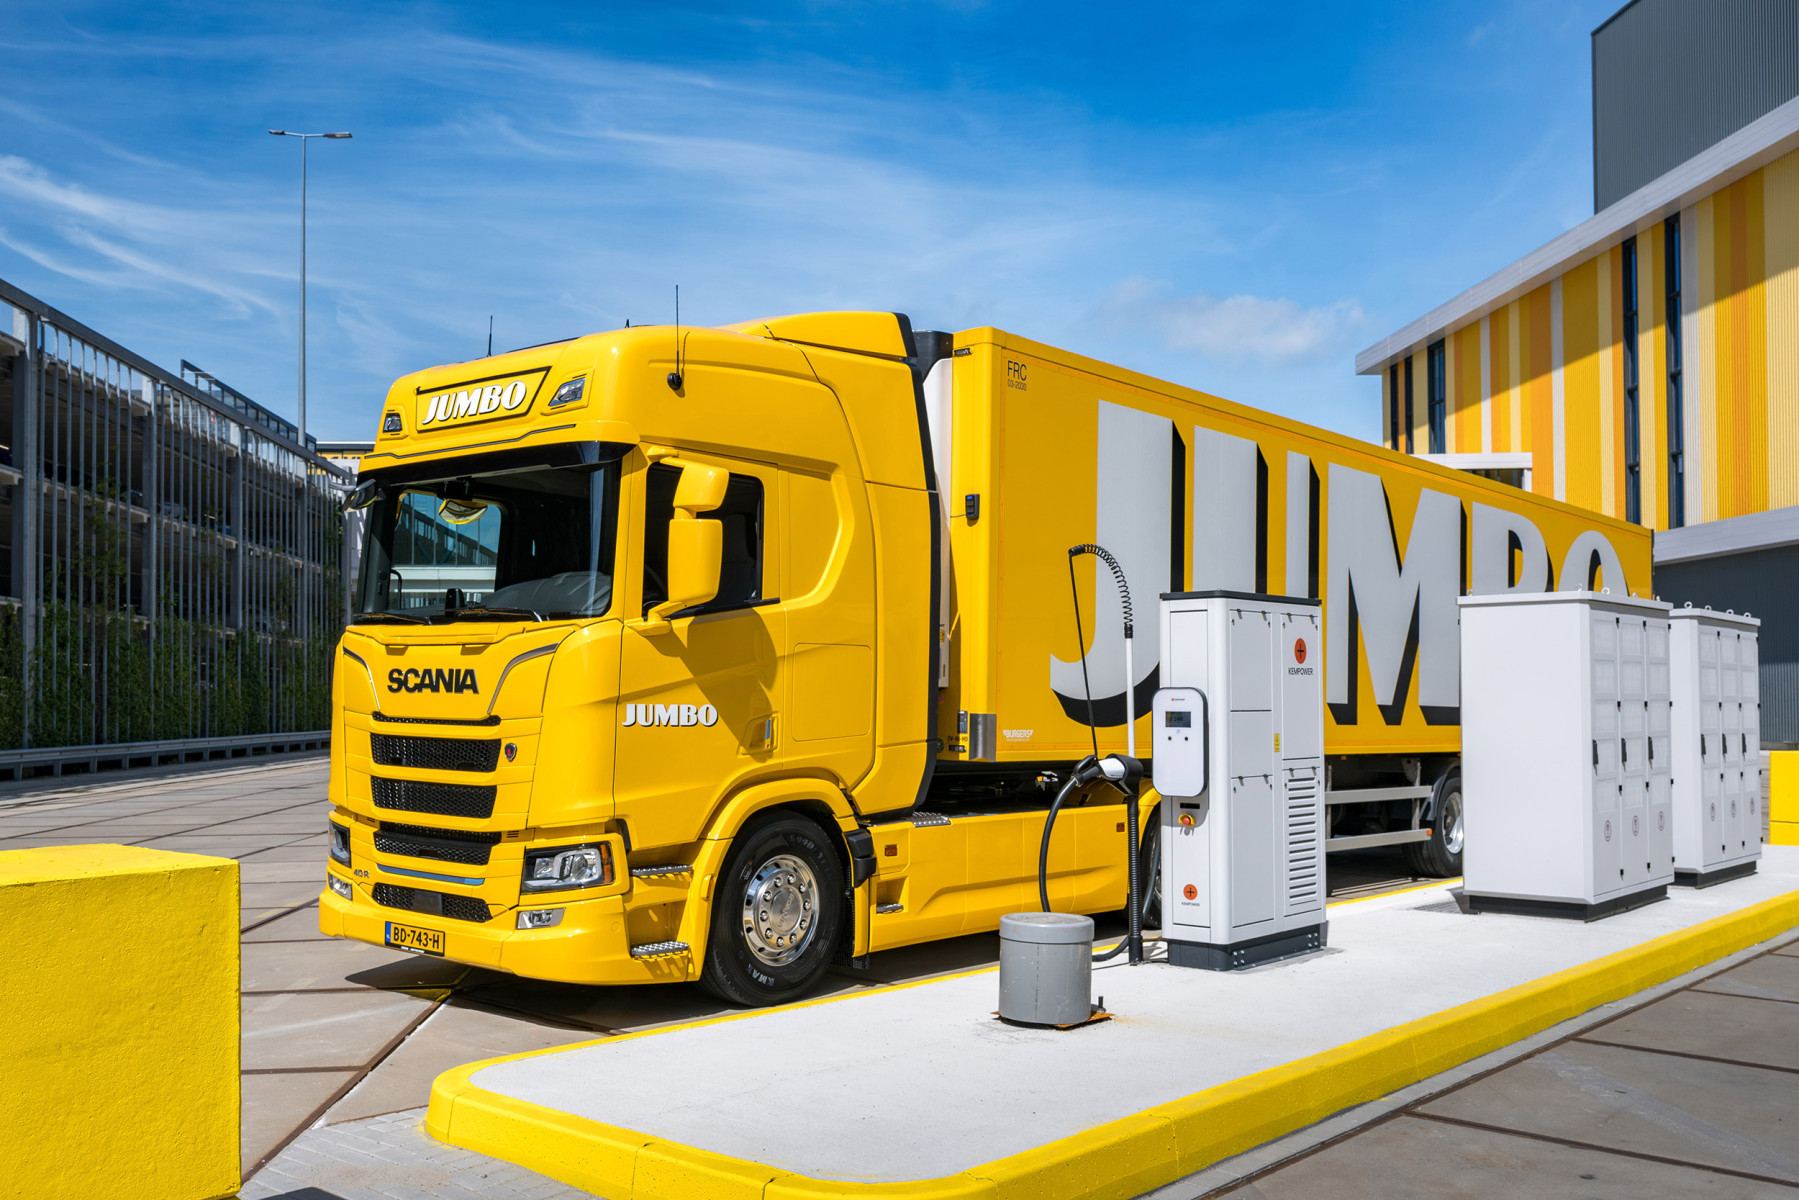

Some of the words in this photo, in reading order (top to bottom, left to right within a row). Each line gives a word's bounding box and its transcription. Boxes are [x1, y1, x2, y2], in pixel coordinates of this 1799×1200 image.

[1007, 360, 1027, 381] FRC
[422, 380, 526, 425] JUMBO
[387, 667, 479, 695] SCANIA
[1288, 667, 1314, 676] KEMPOWER
[621, 703, 718, 728] JUMBO
[393, 926, 440, 950] BD-743-H
